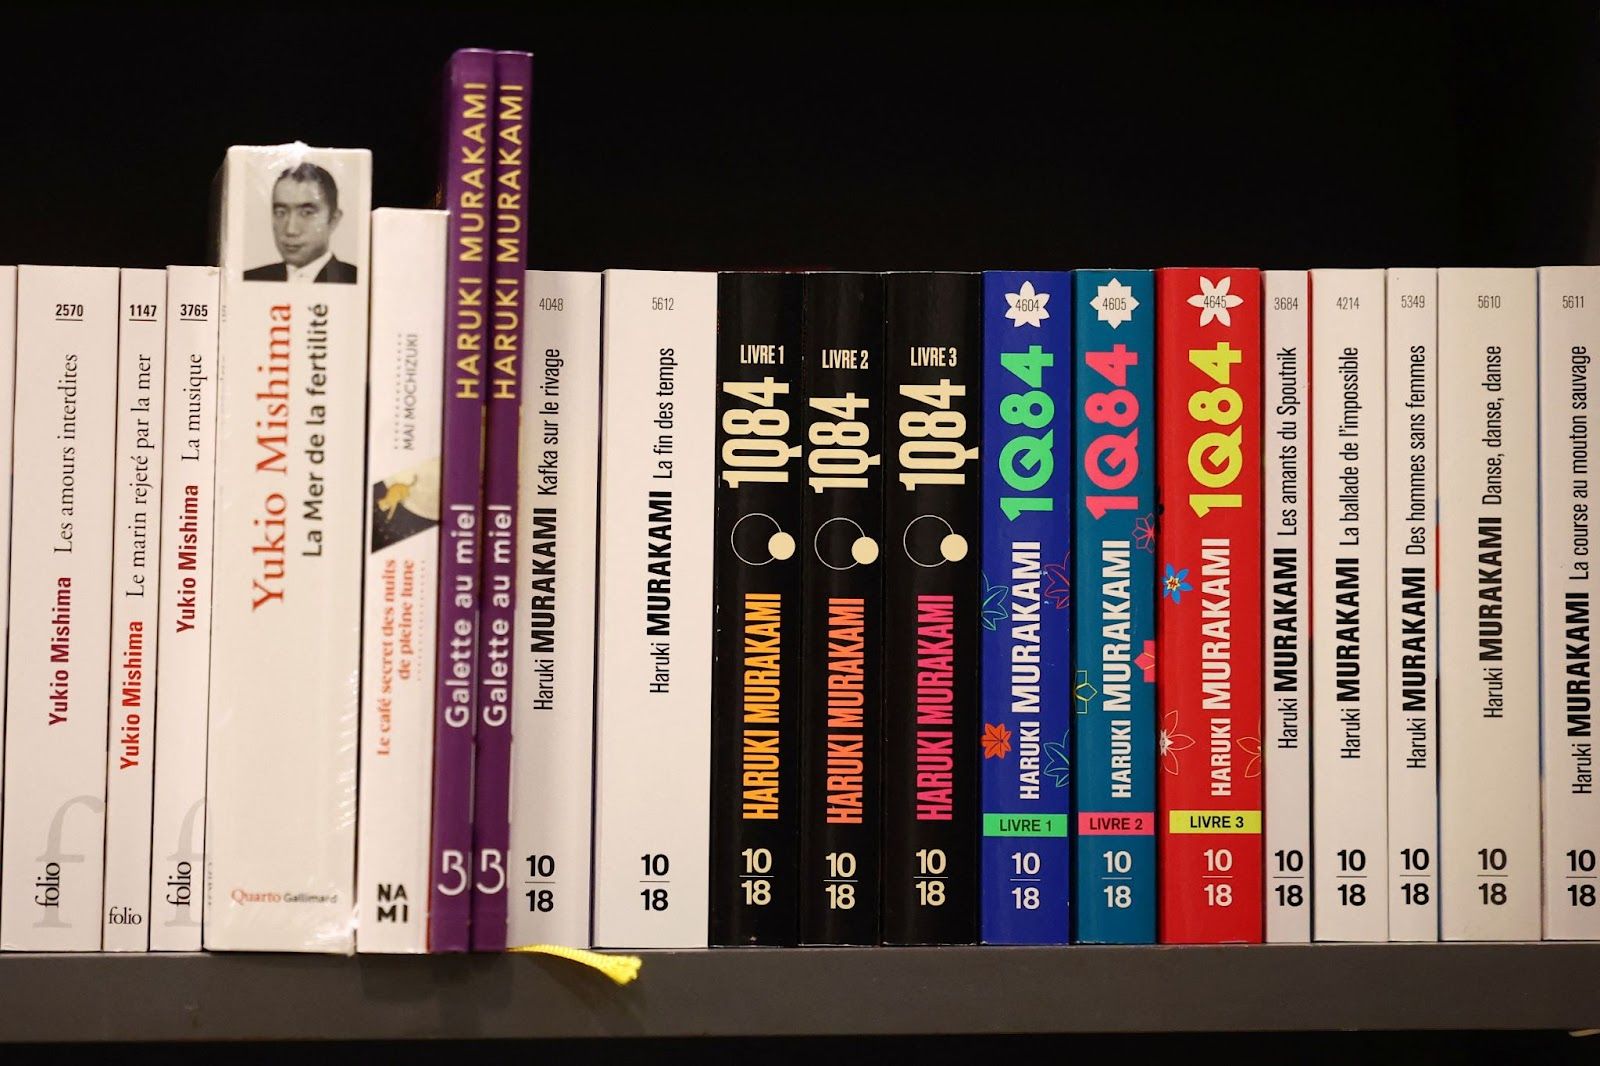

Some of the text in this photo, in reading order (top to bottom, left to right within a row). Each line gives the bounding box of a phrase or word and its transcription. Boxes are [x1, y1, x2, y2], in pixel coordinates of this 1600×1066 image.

[456, 83, 486, 398] HARUKI MURAKAMI
[494, 85, 523, 398] HARUKI MURAKAMI
[56, 304, 83, 316] 2570
[130, 305, 156, 317] 1147
[181, 304, 207, 316] 3765
[539, 298, 563, 311] 4048
[652, 297, 674, 310] 5612
[1016, 299, 1039, 311] 4604
[1102, 298, 1126, 310] 4605
[1204, 296, 1226, 308] 4645
[1275, 297, 1298, 310] 3684
[1336, 297, 1359, 309] 4214
[1402, 295, 1425, 308] 5349
[1478, 296, 1500, 308] 5610
[1563, 296, 1583, 308] 5611
[741, 345, 784, 364] LIVRE 1
[822, 350, 868, 369] LIVRE 2
[911, 347, 957, 367] LIVRE 3
[403, 334, 418, 450] MAI MOCHIZUKI
[302, 304, 328, 556] La Mer de la fertilité
[722, 377, 802, 488] 1Q84
[899, 379, 978, 491] 1Q84
[999, 345, 1054, 521] 1Q84
[1085, 344, 1139, 519] 1Q84
[1188, 342, 1243, 517] 1Q84
[808, 393, 880, 493] 1Q84
[1339, 443, 1358, 460] de
[252, 305, 291, 610] Yukio Mishima
[177, 354, 207, 632] Yukio Mishima La musique
[1339, 467, 1358, 521] ballade
[531, 349, 563, 709] Haruki MURAKAMI Kafka sur le rivage
[647, 349, 678, 693] Haruki MURAKAMI La fin des temps
[1479, 347, 1504, 717] Haruki MURAKAMI Danse, danse, danse
[49, 355, 77, 725] Yukio Mishima Les amours interdites
[1274, 348, 1300, 748] Haruki MURAKAMI Les amants du Spoutnik
[1340, 528, 1359, 545] La
[120, 358, 154, 769] Yukio Mishima Le marin rejeté par la mer
[1402, 346, 1426, 768] Haruki MURAKAMI Des hommes sans femmes
[1566, 346, 1591, 793] Haruki MURAKAMI La course au mouton sauvage
[399, 560, 414, 680] de pleine lune
[445, 505, 474, 727] Galette au miel
[483, 505, 511, 726] Galette au miel
[1336, 559, 1360, 701] MURAKAMI
[377, 559, 396, 755] Le café secret des nuits
[1102, 541, 1131, 797] HARUKI MURAKAMI
[1202, 539, 1231, 795] HARUKI MURAKAMI
[1012, 542, 1042, 799] HARUKI MURAKAMI
[743, 594, 781, 819] HARUKI MURAKAMI
[827, 598, 864, 823] HARUKI MURAKAMI
[917, 595, 953, 820] HARUKI MURAKAMI
[1341, 709, 1360, 758] Haruki
[1000, 819, 1051, 831] LIVRE 1
[1090, 818, 1143, 830] LIVRE 2
[1191, 816, 1243, 828] LIVRE 3
[526, 855, 554, 877] 10
[742, 848, 772, 873] 10
[916, 849, 946, 874] 10
[1103, 851, 1131, 873] 10
[1275, 850, 1303, 871] 10
[1337, 850, 1365, 871] 10
[1478, 849, 1507, 870] 10
[35, 863, 60, 907] folio
[167, 862, 191, 905] folio
[378, 884, 407, 901] NA
[741, 880, 771, 905] 18
[916, 881, 945, 906] 18
[1275, 885, 1303, 906] 18
[1338, 884, 1365, 906] 18
[1479, 883, 1507, 905] 18
[231, 889, 281, 905] Quarto
[526, 890, 553, 912] 18
[1104, 886, 1131, 908] 18
[109, 907, 141, 924] folio
[378, 905, 408, 922] MI
